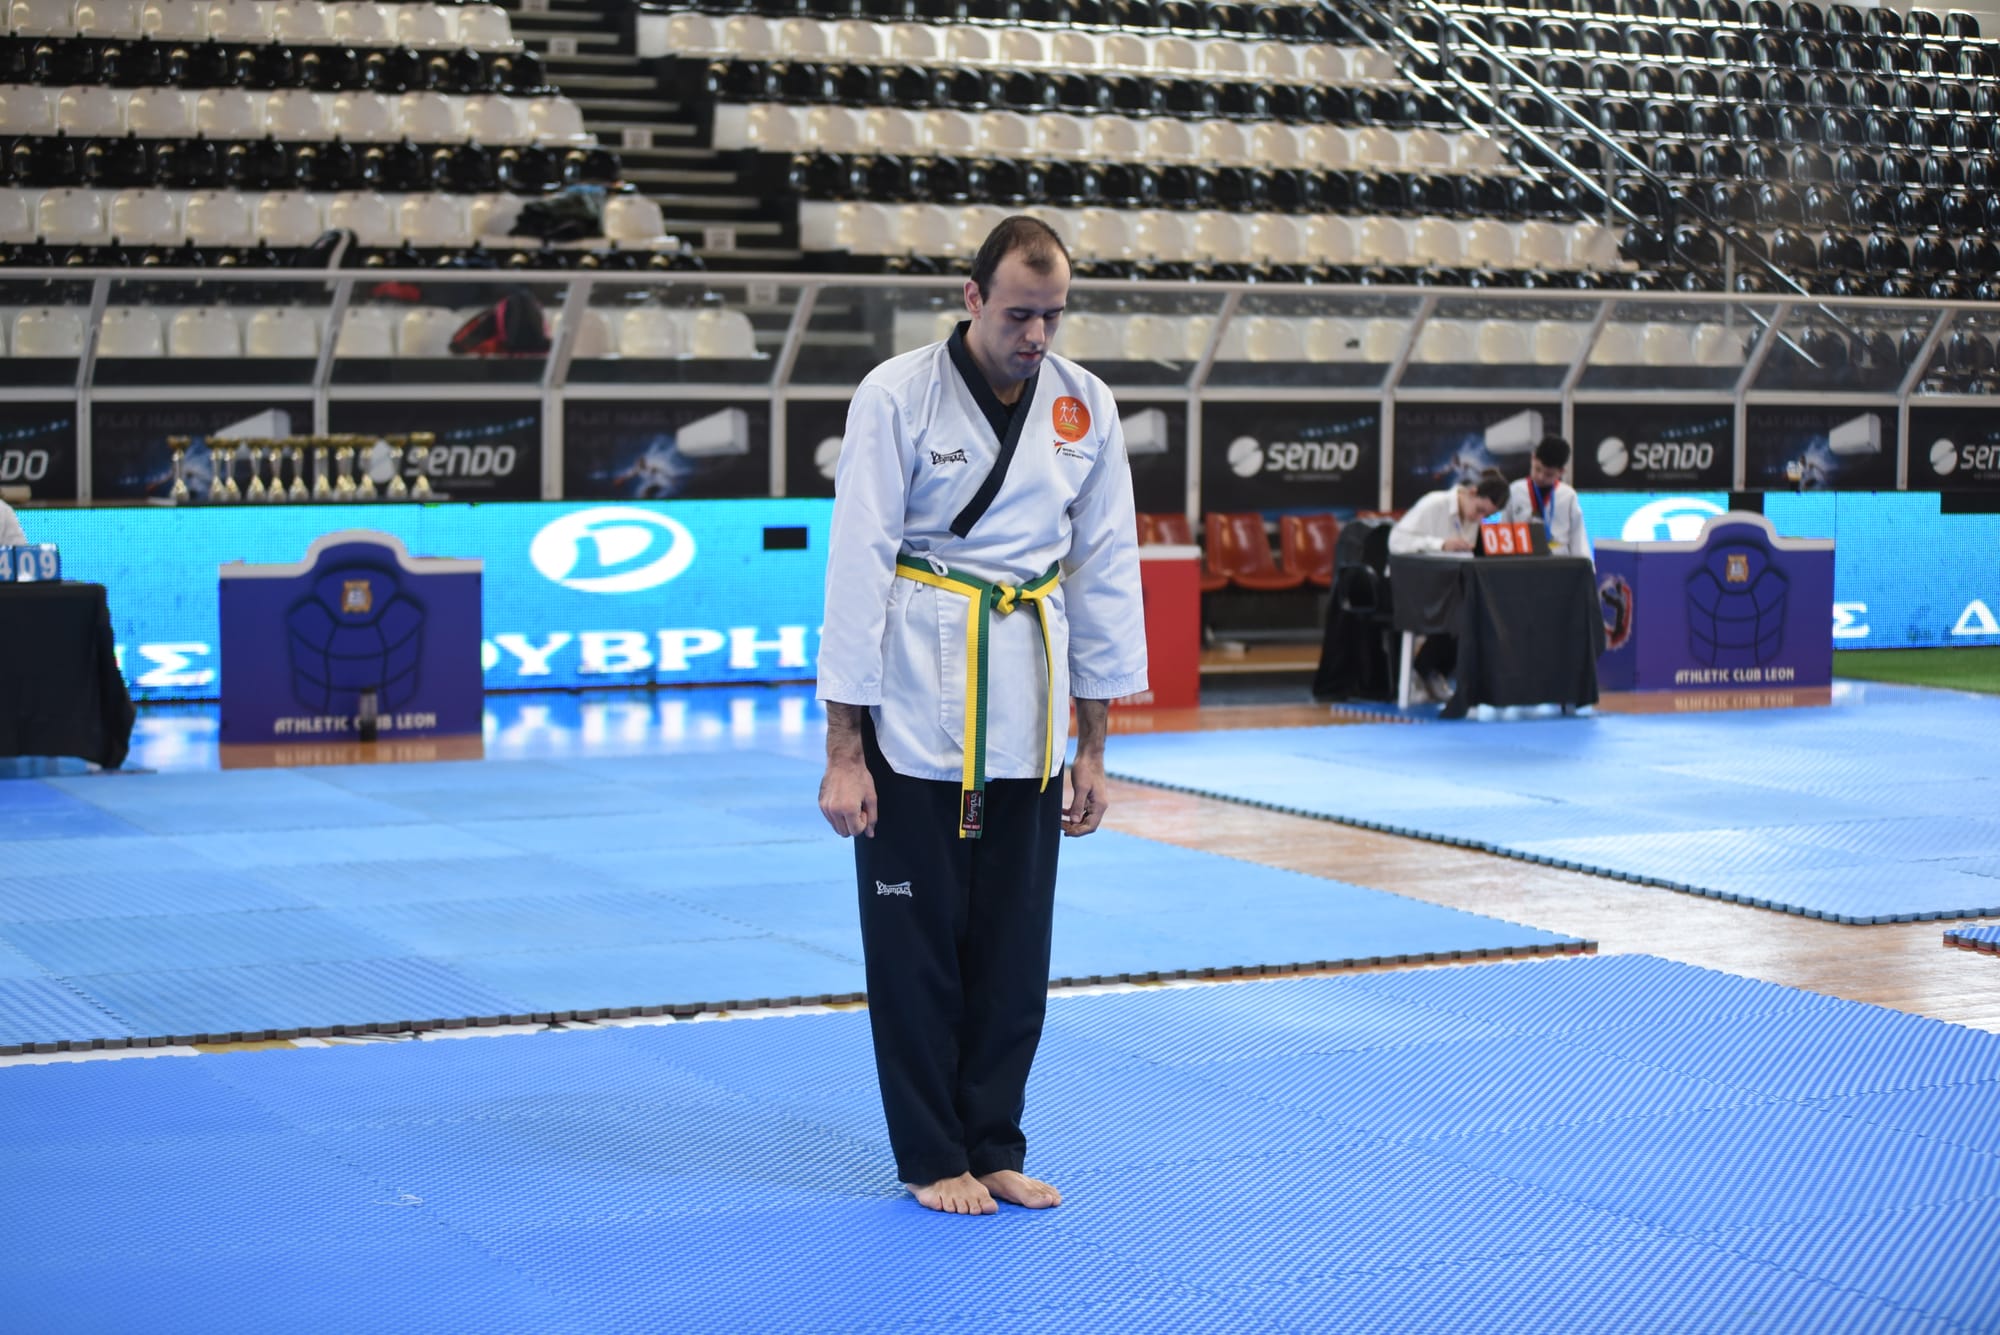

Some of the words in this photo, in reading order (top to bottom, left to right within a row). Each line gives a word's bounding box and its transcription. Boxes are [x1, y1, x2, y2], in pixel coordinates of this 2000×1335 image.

[0, 450, 49, 480] DO
[482, 625, 824, 676] ΥΒΡΗ
[1675, 668, 1729, 685] ATHLETIC
[1733, 667, 1761, 682] CLUB
[1765, 667, 1794, 682] LEON
[274, 715, 348, 735] ATHLETIC
[397, 712, 437, 729] LEON
